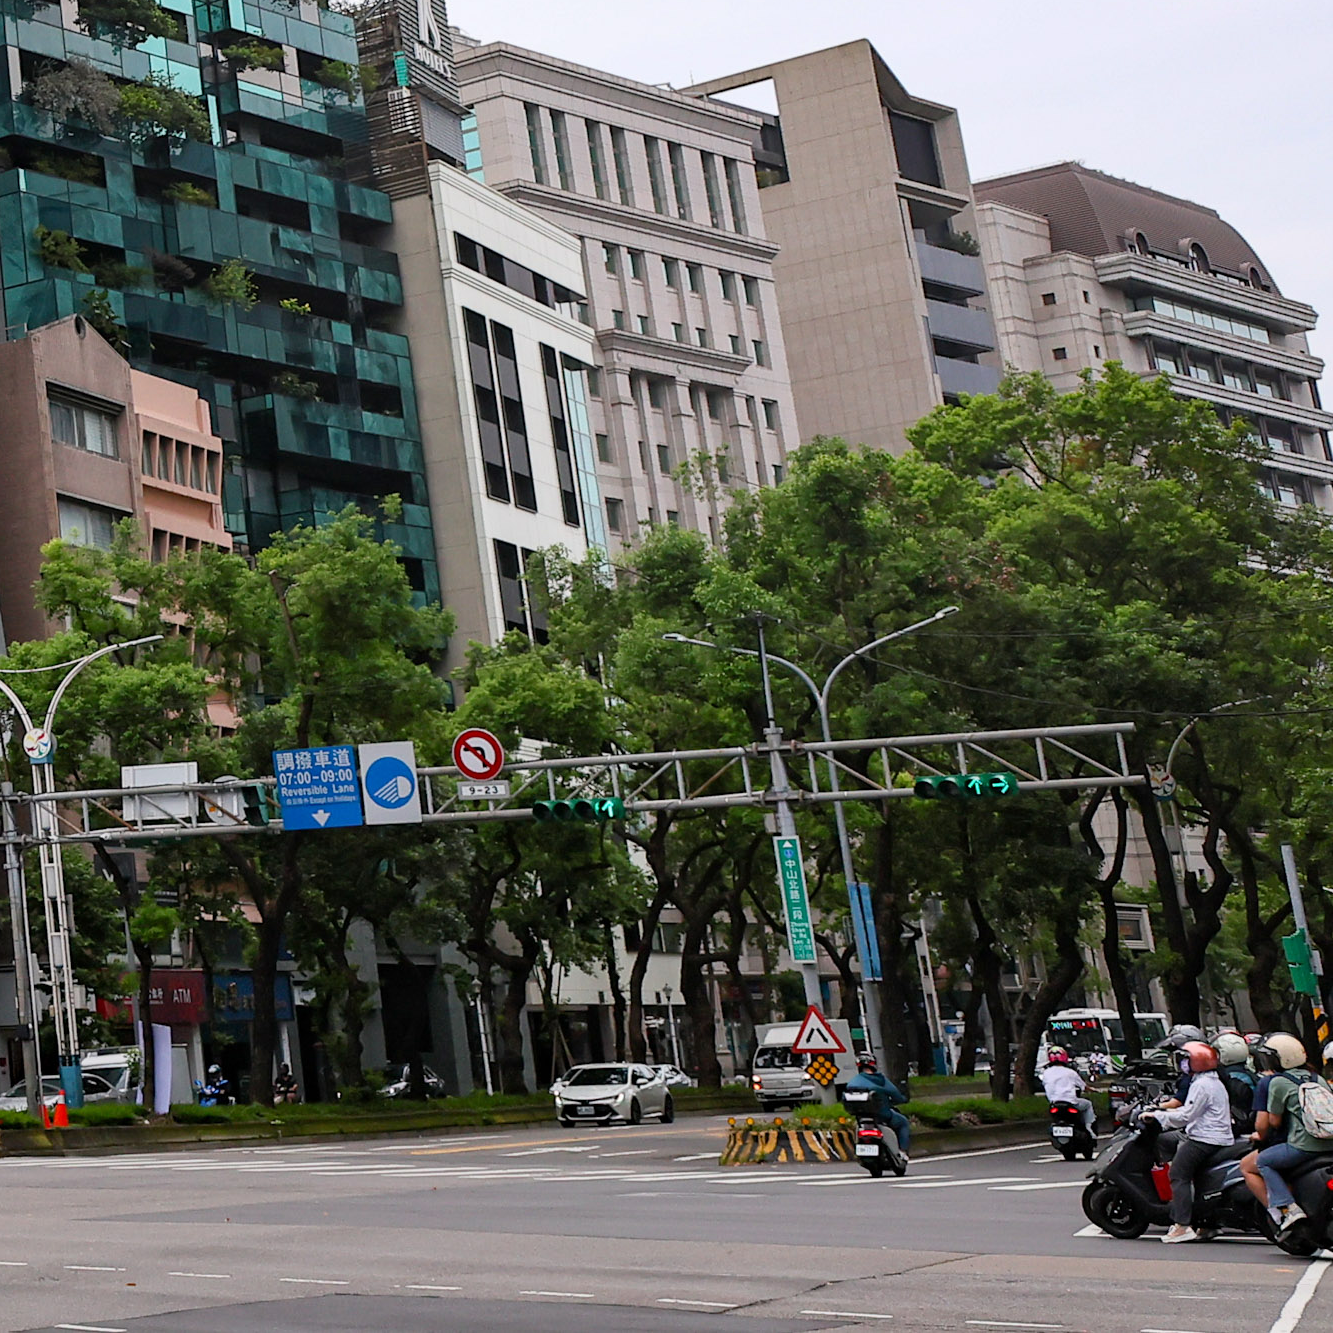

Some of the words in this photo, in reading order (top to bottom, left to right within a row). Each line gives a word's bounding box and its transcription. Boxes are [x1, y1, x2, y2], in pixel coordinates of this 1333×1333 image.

[276, 749, 351, 772] 調撥車道
[281, 786, 328, 797] Reversible
[333, 784, 355, 794] Lane
[469, 786, 498, 794] 9-23
[784, 859, 803, 920] 中山北路二段
[173, 988, 192, 1004] ATM
